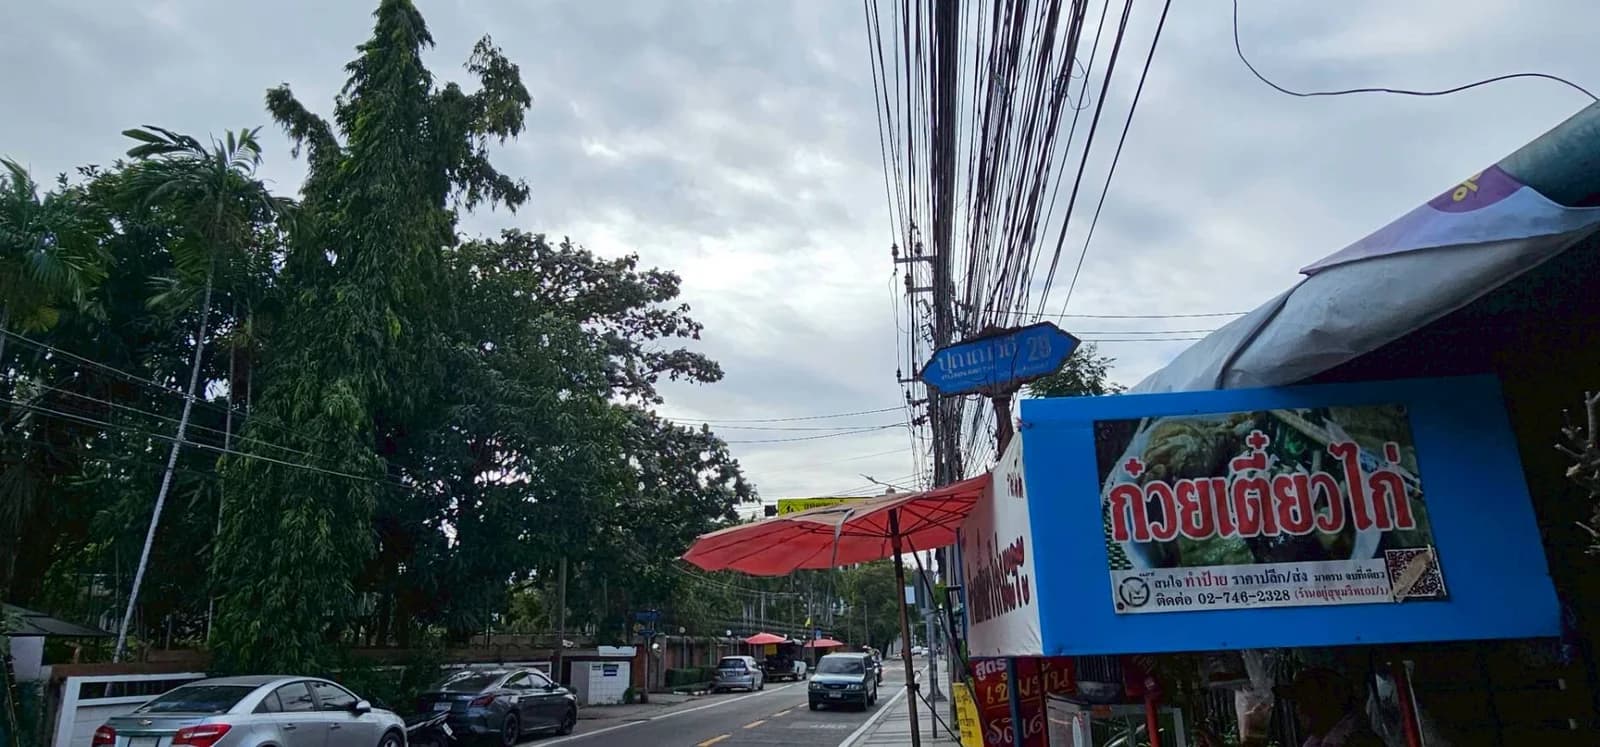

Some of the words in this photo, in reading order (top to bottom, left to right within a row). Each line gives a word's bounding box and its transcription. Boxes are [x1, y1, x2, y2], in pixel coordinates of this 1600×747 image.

[1108, 429, 1416, 543] ก๋วยเตี๋ยวไก่
[1154, 574, 1182, 588] สนใจ
[1184, 569, 1228, 587] ทำป้าย
[1232, 567, 1308, 586] ราคาปลีก/ส่ง
[1156, 592, 1193, 607] ติดต่อ
[1197, 589, 1291, 605] 02-746-2328
[975, 658, 1008, 681] สูตร
